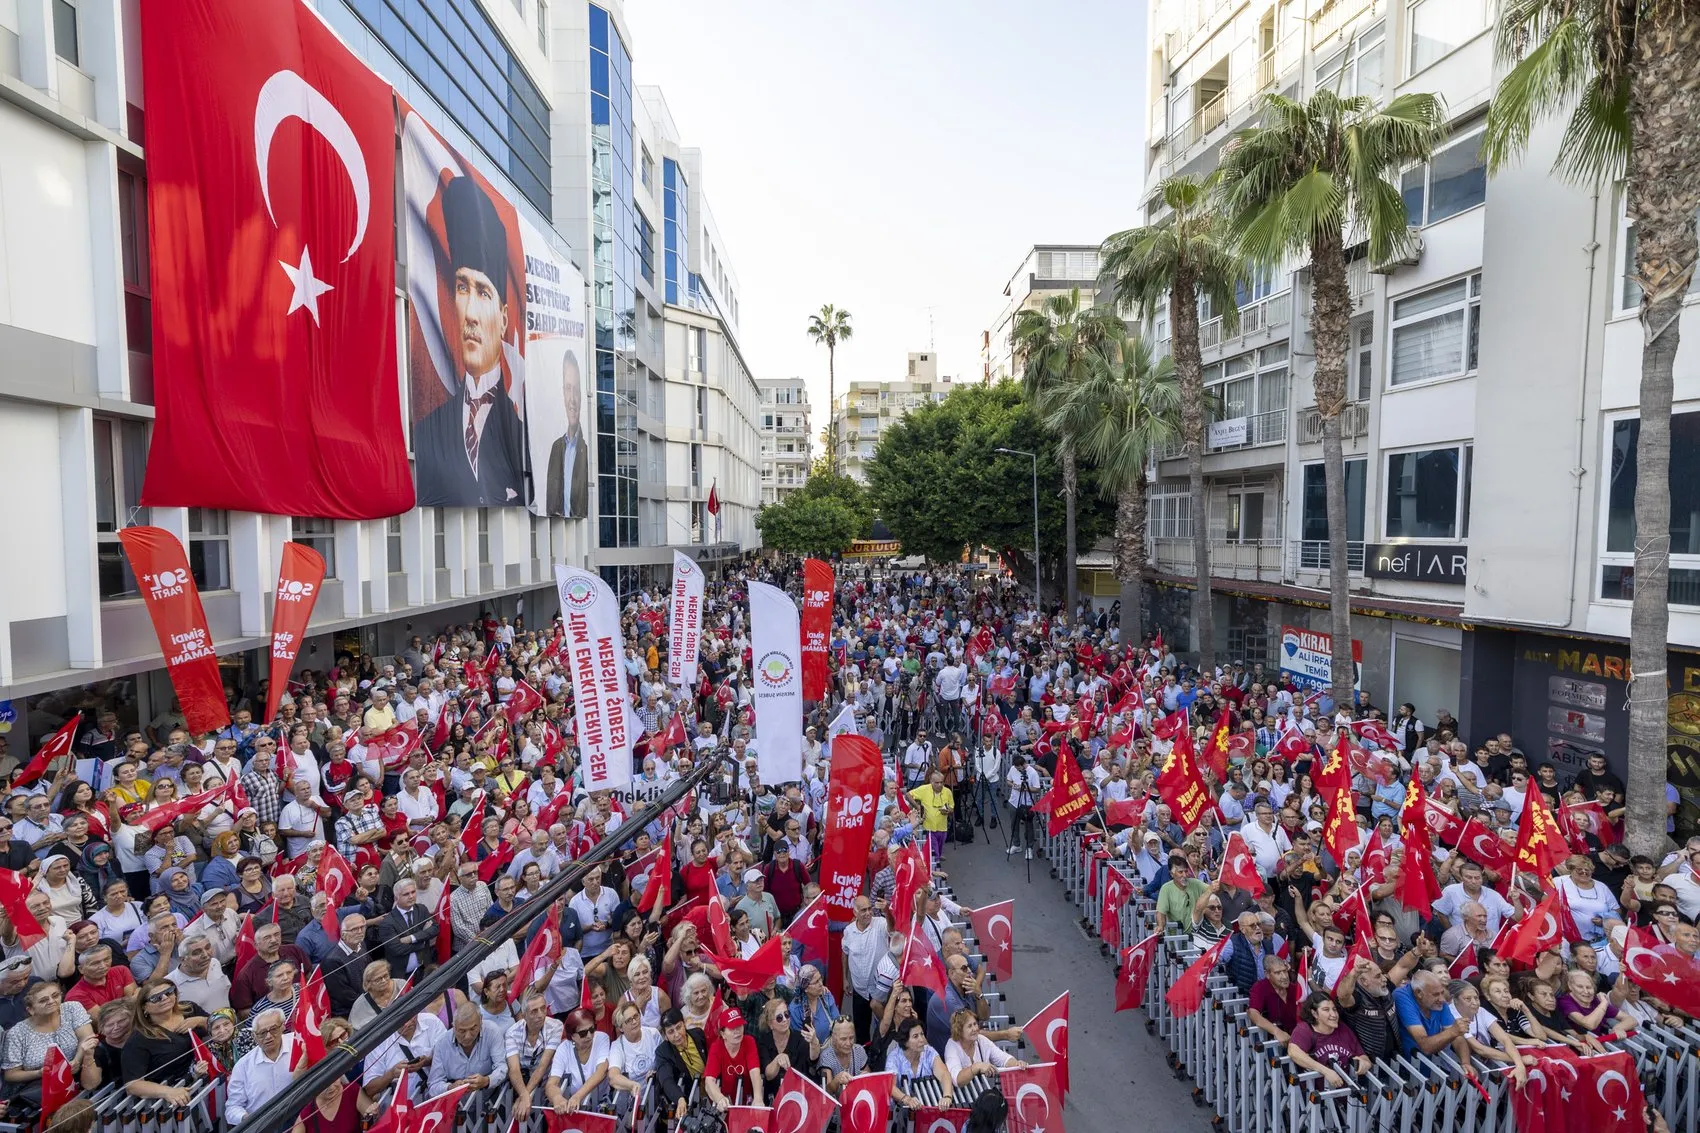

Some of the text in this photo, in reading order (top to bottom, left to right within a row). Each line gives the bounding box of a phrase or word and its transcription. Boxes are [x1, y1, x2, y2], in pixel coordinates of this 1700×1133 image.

[1378, 552, 1411, 573] nef
[1312, 654, 1332, 668] İRFA
[1305, 664, 1329, 678] TEMİR
